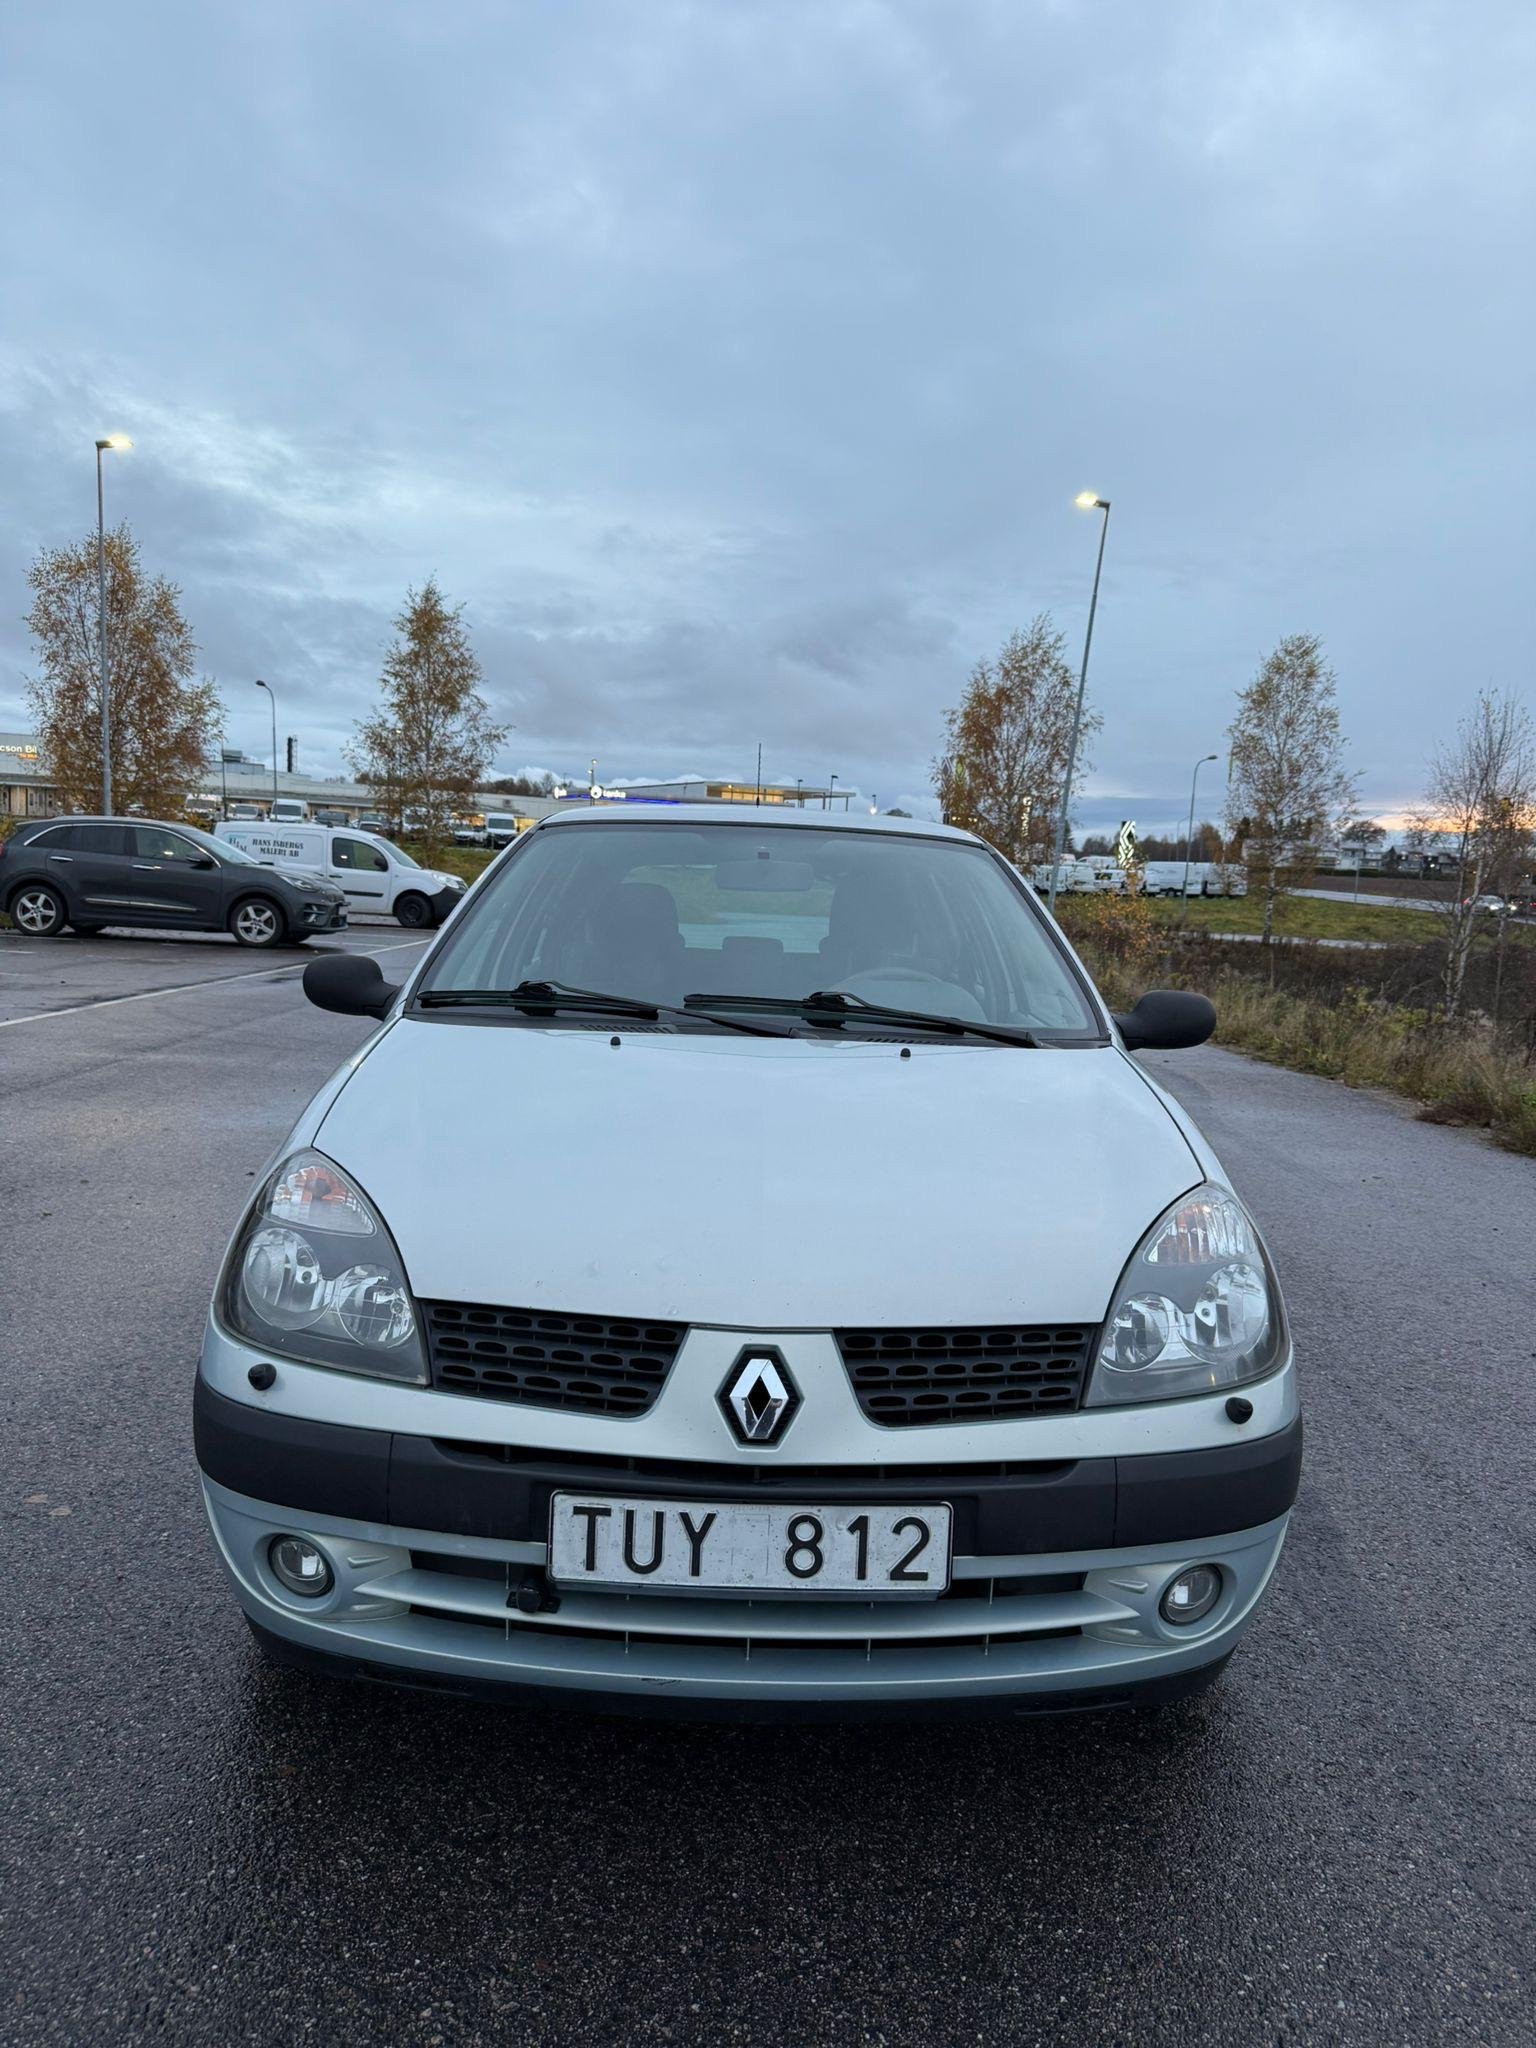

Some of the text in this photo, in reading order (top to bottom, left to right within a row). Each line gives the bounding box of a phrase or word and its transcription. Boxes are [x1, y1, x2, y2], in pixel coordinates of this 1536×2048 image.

[252, 838, 271, 847] HANS
[289, 849, 300, 857] AB
[572, 1504, 931, 1582] TUY 812
